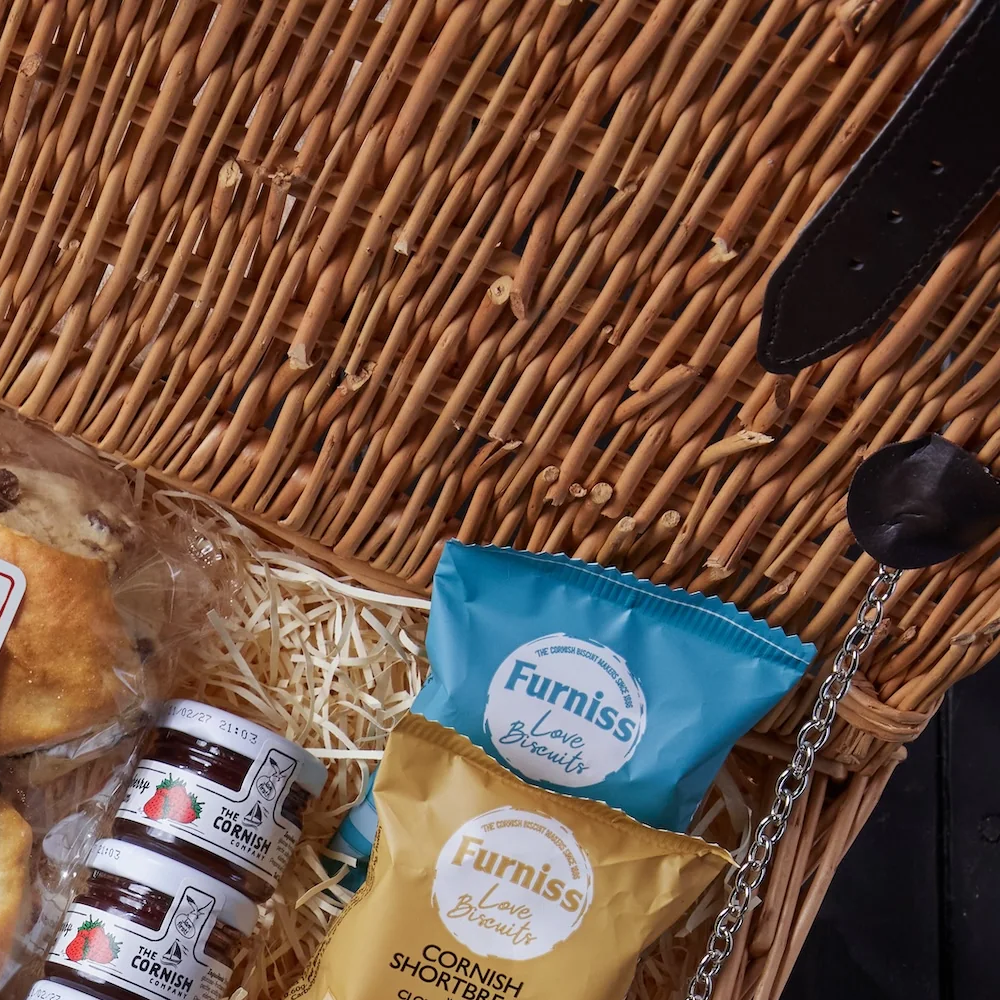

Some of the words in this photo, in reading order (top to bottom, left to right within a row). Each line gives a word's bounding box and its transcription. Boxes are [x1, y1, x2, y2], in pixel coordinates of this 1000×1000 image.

[535, 647, 549, 657] THE
[504, 659, 636, 742] Furniss
[219, 720, 258, 745] 21:03
[500, 720, 590, 776] Biscuits
[530, 710, 585, 750] Love
[220, 806, 240, 821] THE
[212, 816, 273, 856] CORNISH
[230, 839, 266, 862] COMPANY
[451, 835, 584, 913] Furniss
[447, 893, 537, 946] Biscuits
[478, 883, 533, 920] Love
[138, 945, 158, 961] THE
[422, 944, 524, 998] CORNISH
[131, 955, 194, 993] CORNISH
[149, 978, 189, 1000] COMPANY
